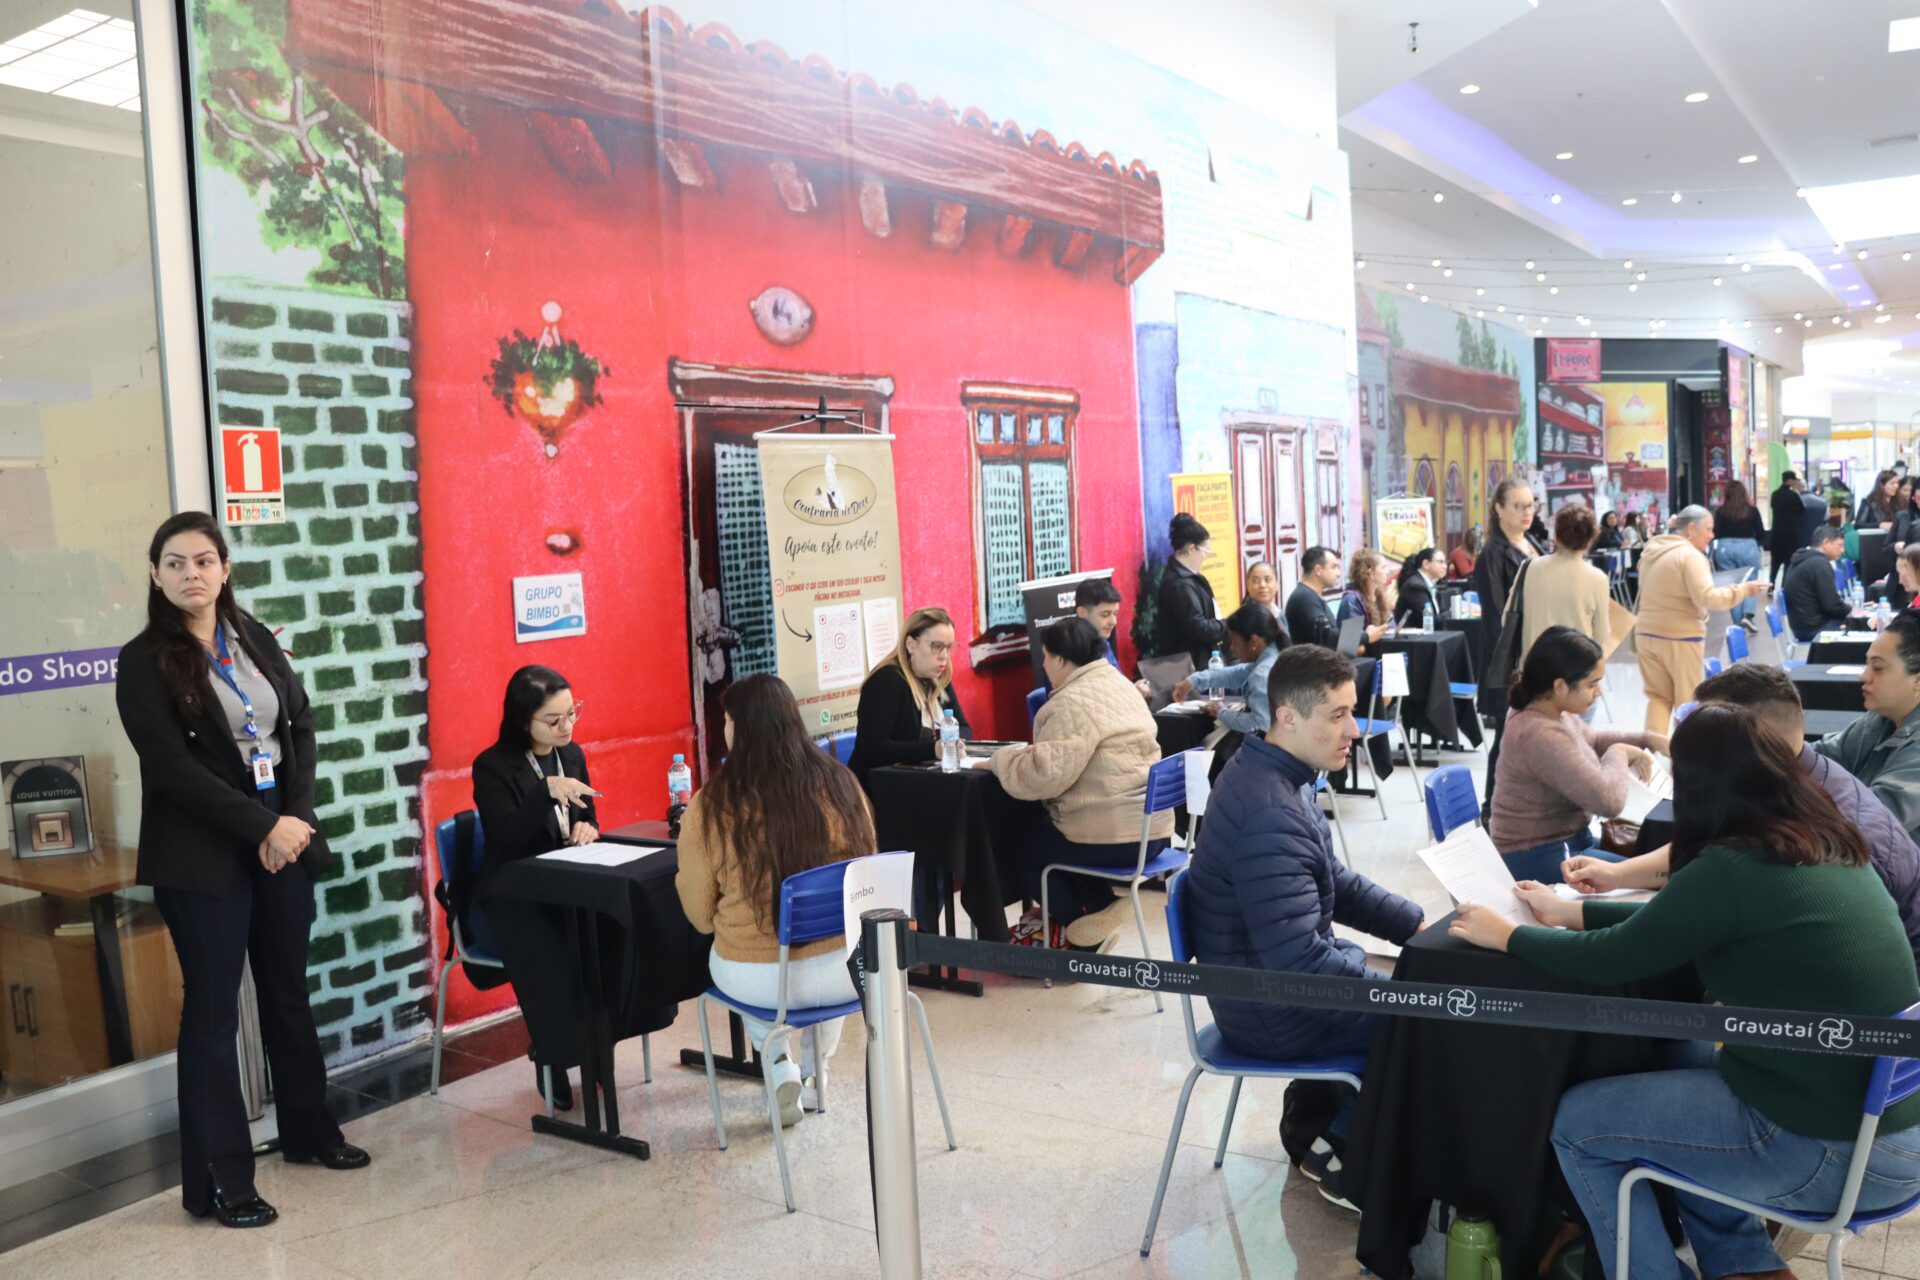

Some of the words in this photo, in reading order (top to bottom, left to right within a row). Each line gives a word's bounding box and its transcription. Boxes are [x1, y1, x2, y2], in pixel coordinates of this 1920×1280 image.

[784, 536, 818, 563] Apoia
[821, 532, 842, 555] este
[845, 530, 878, 552] evento!
[525, 585, 562, 601] GRUPO
[526, 605, 560, 621] BIMBO
[0, 662, 33, 686] do
[17, 791, 40, 800] LOUIS
[42, 788, 76, 798] VUITTON
[1068, 959, 1132, 978] Gravataí
[1163, 971, 1200, 981] SHOPPING
[1369, 988, 1443, 1007] Gravataí
[1481, 999, 1524, 1008] SHOPPING
[1724, 1017, 1814, 1038] Gravataí
[1860, 1030, 1912, 1039] SHOPPING
[1859, 1036, 1899, 1044] CENTER
